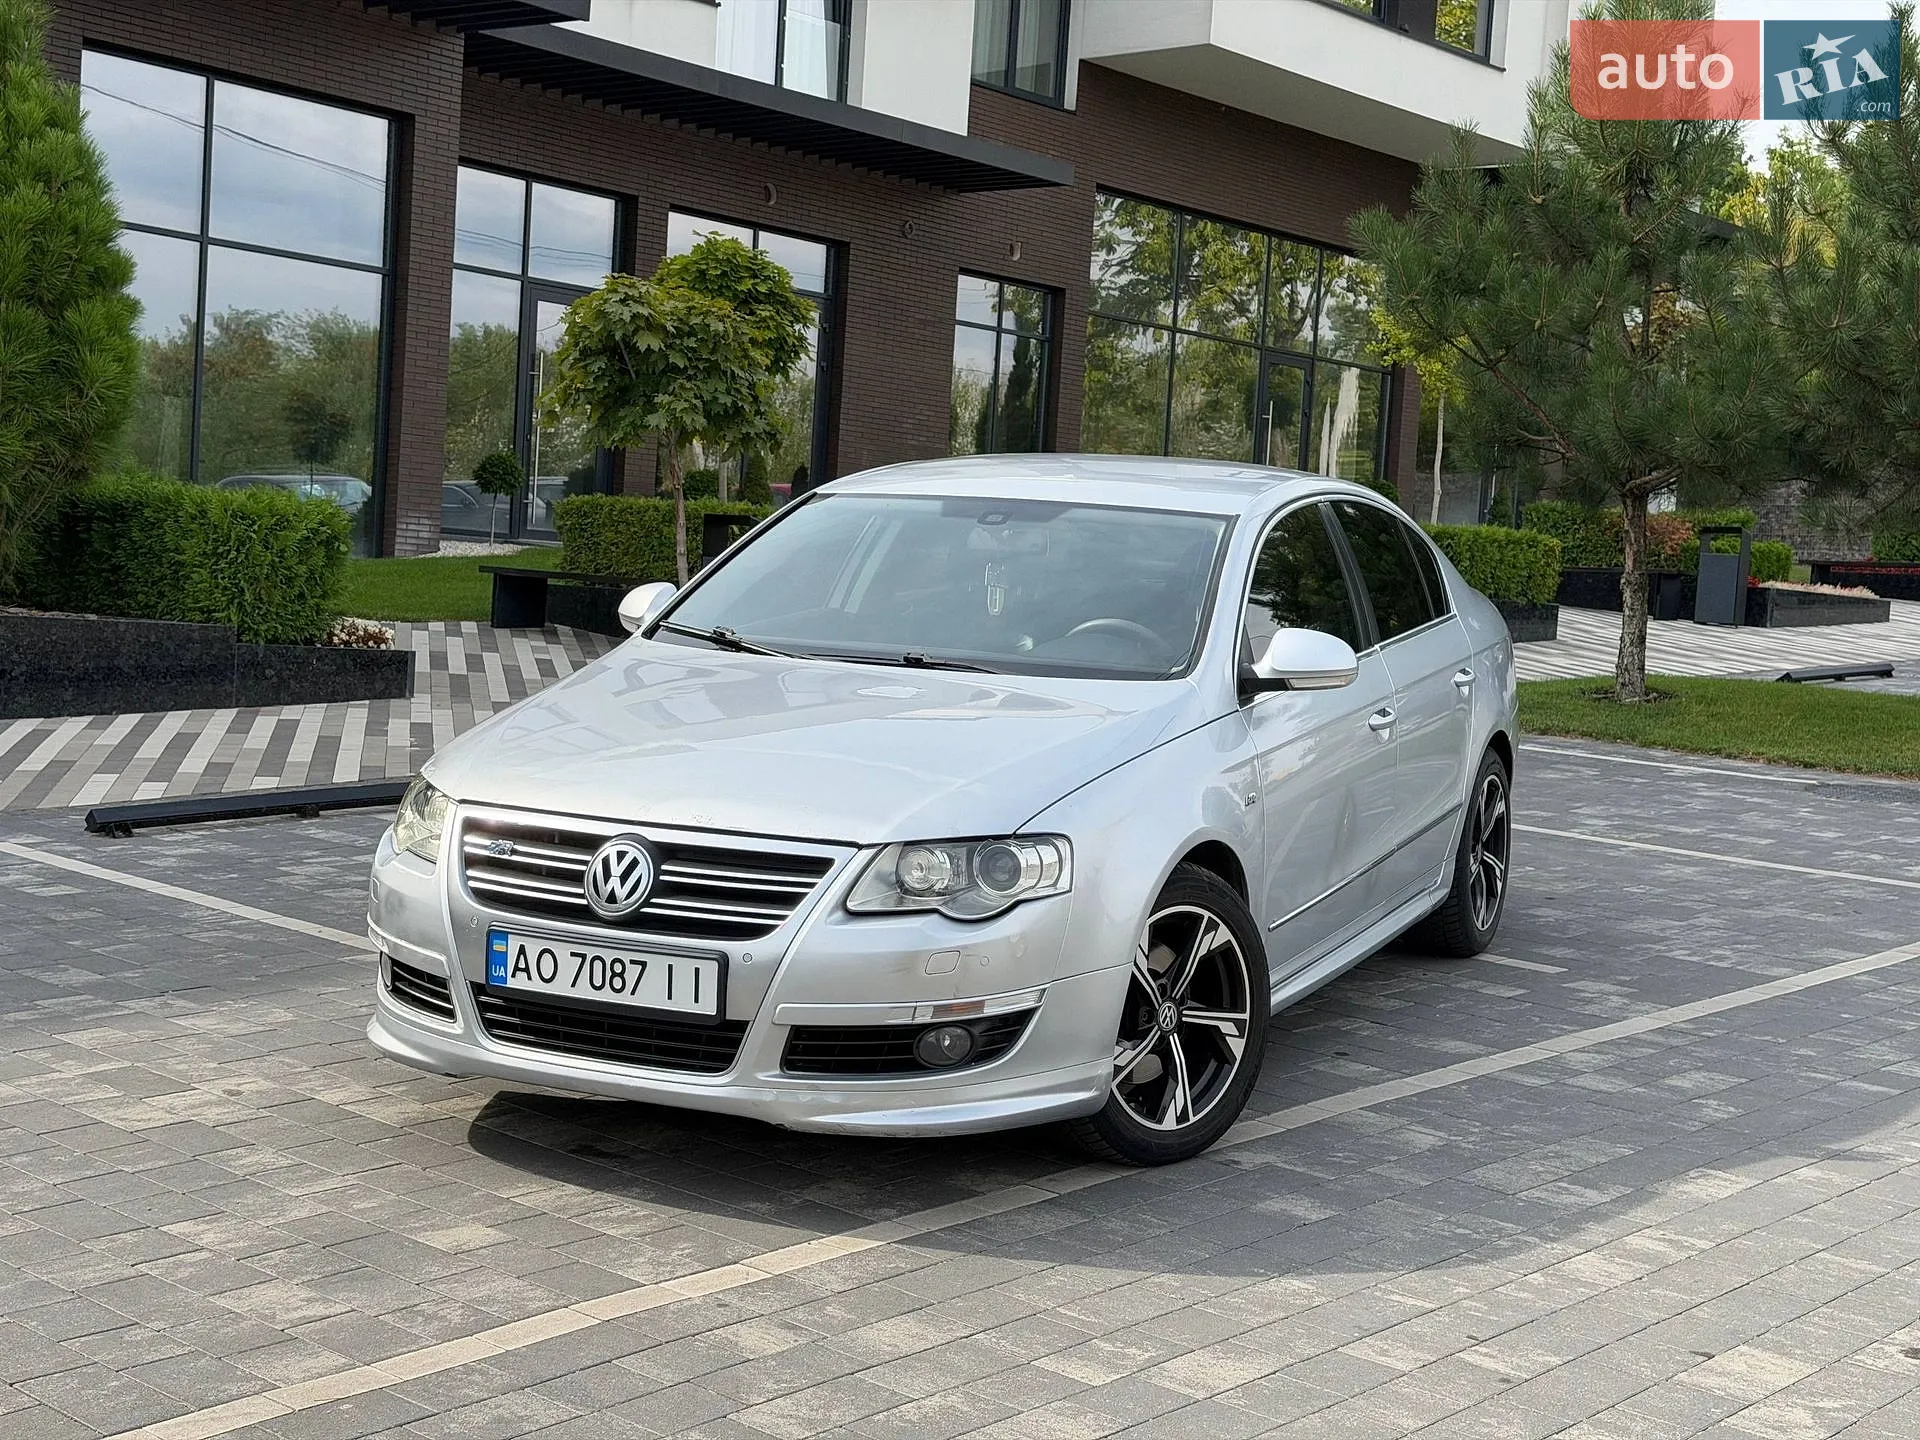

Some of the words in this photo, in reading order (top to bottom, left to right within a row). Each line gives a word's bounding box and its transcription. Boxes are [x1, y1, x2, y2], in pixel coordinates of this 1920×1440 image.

[491, 965, 507, 978] UA
[510, 943, 559, 984] AO
[569, 951, 648, 996] 7087
